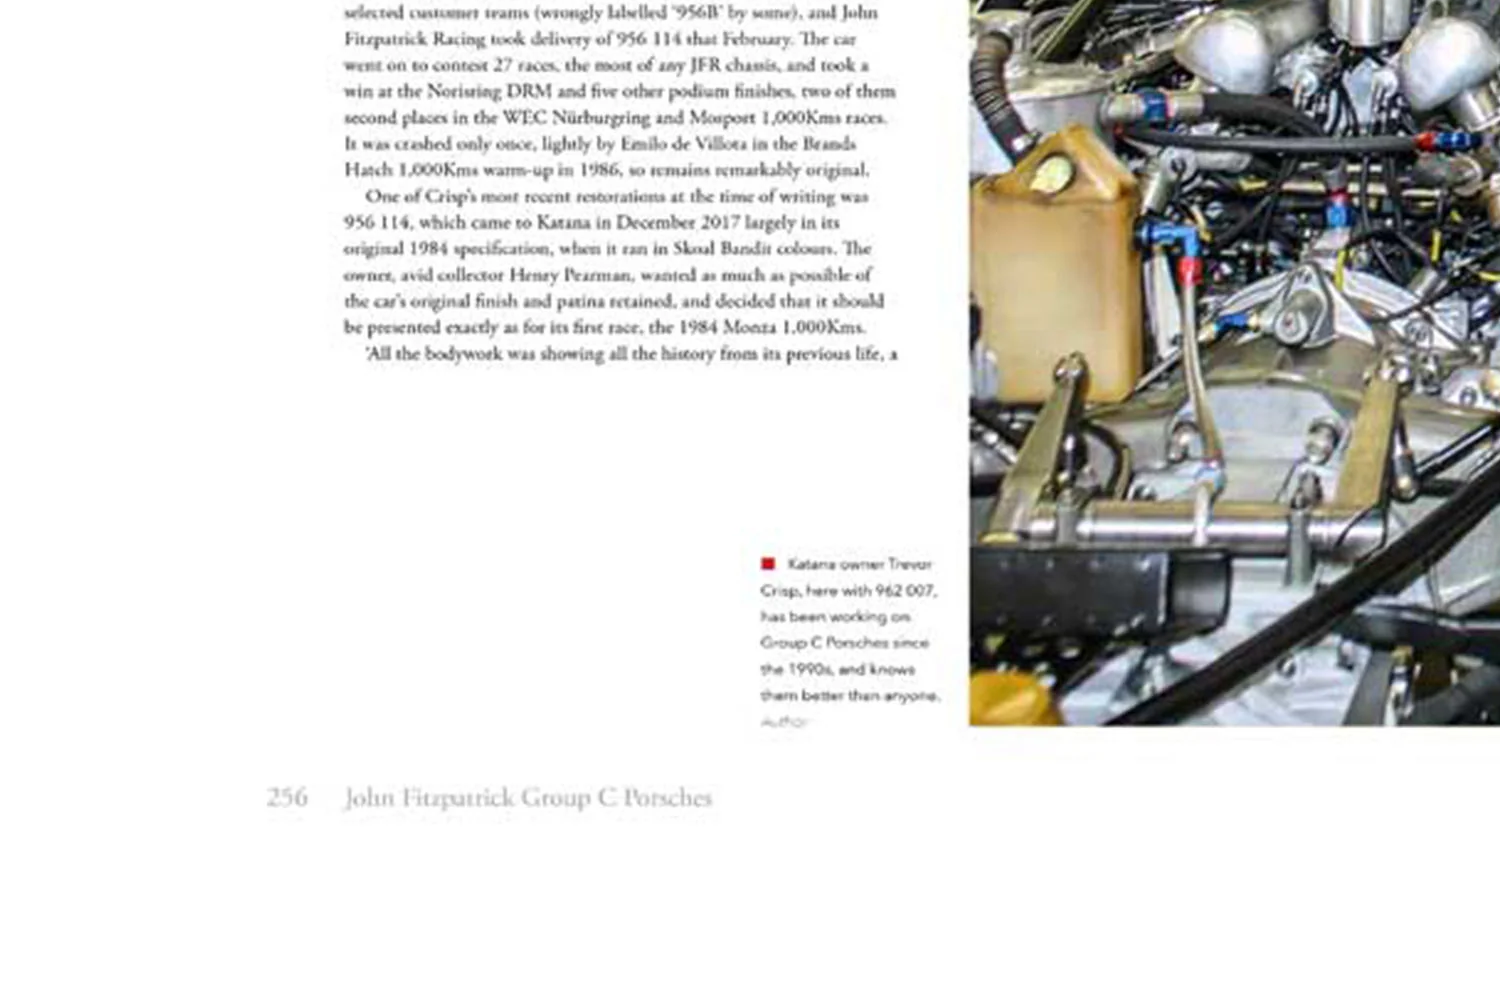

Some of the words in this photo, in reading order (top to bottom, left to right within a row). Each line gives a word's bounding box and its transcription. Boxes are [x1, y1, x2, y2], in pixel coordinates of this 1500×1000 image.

[344, 3, 405, 21] selected
[409, 7, 479, 21] customer
[485, 8, 530, 21] teams
[534, 3, 603, 25] (wrongly
[607, 3, 668, 21] labelled
[727, 3, 746, 20] by
[808, 3, 837, 21] and
[842, 2, 879, 22] John
[344, 85, 374, 100] win
[377, 86, 393, 100] at
[397, 81, 423, 100] the
[506, 81, 552, 100] DRM
[557, 82, 587, 100] and
[590, 82, 618, 100] five
[621, 81, 664, 100] other
[668, 82, 730, 104] podium
[834, 83, 852, 100] of
[855, 81, 897, 100] them
[343, 213, 376, 231] 956
[419, 213, 467, 231] which
[470, 218, 512, 231] came
[515, 217, 533, 231] to
[537, 212, 592, 231] Katana
[596, 217, 612, 231] in
[616, 212, 696, 231] December
[701, 213, 741, 231] 2017
[745, 213, 797, 236] largely
[801, 216, 817, 231] in
[820, 216, 841, 231] its
[344, 291, 369, 310] the
[409, 291, 471, 315] original
[475, 291, 518, 310] finish
[523, 292, 552, 310] and
[556, 296, 606, 314] patina
[682, 292, 711, 310] and
[714, 291, 776, 310] decided
[779, 291, 811, 310] that
[816, 296, 828, 309] it
[832, 291, 885, 310] should
[395, 344, 421, 362] the
[424, 344, 503, 366] bodywork
[507, 349, 536, 362] was
[540, 344, 605, 367] showing
[609, 344, 628, 362] all
[631, 344, 658, 362] the
[661, 344, 716, 363] history
[720, 344, 759, 362] from
[762, 348, 782, 362] its
[786, 347, 851, 367] previous
[788, 557, 836, 572] Katana
[839, 559, 885, 572] owner
[888, 554, 932, 572] Trevor
[805, 583, 839, 598] here
[842, 583, 873, 598] with
[875, 581, 903, 599] 962
[761, 610, 786, 624] has
[789, 609, 826, 624] been
[830, 610, 888, 628] working
[891, 611, 911, 624] on
[759, 633, 808, 651] Group
[826, 634, 889, 650] Porsches
[893, 638, 929, 650] since
[760, 662, 784, 677] the
[838, 662, 866, 677] and
[869, 661, 916, 677] knows
[760, 689, 799, 703] them
[801, 687, 843, 703] better
[848, 687, 881, 703] than
[266, 786, 309, 808] 256
[344, 785, 395, 811] John
[403, 785, 516, 812] Fitzpatrick
[520, 786, 592, 813] Group
[597, 786, 617, 807] C
[624, 785, 713, 809] Porsches
